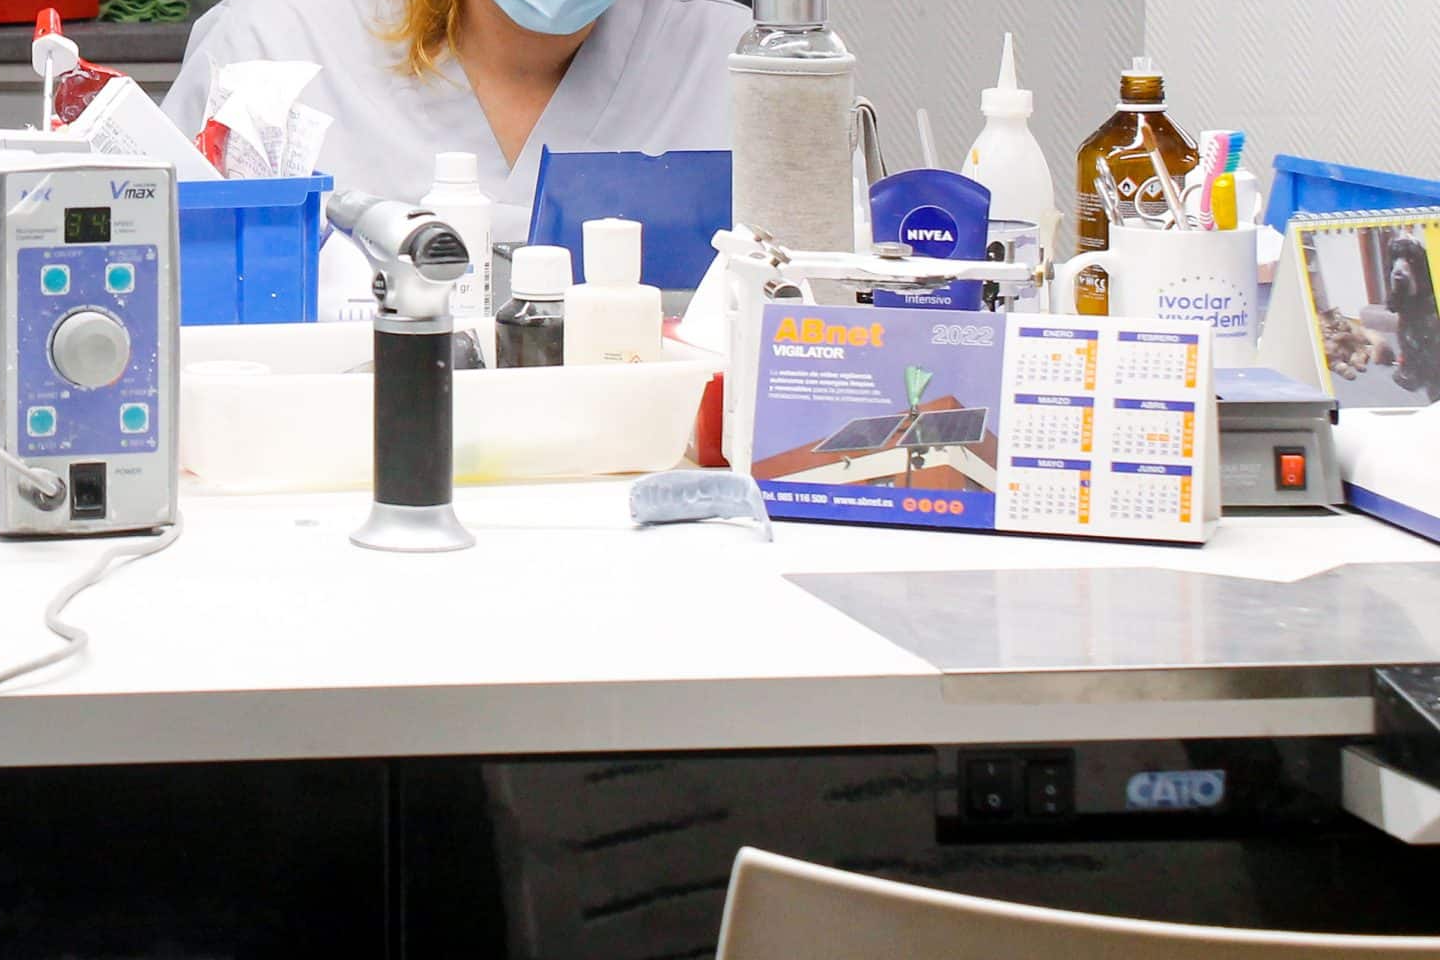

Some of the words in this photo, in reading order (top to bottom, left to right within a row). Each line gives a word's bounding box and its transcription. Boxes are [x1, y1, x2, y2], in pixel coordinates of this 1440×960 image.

[111, 180, 157, 200] Vmax
[907, 229, 954, 242] NIVEA
[905, 295, 952, 305] Intensivo
[1159, 294, 1231, 310] ivoclar
[774, 317, 884, 346] ABnet
[931, 324, 995, 346] 2022
[772, 344, 845, 360] VIGILATOR
